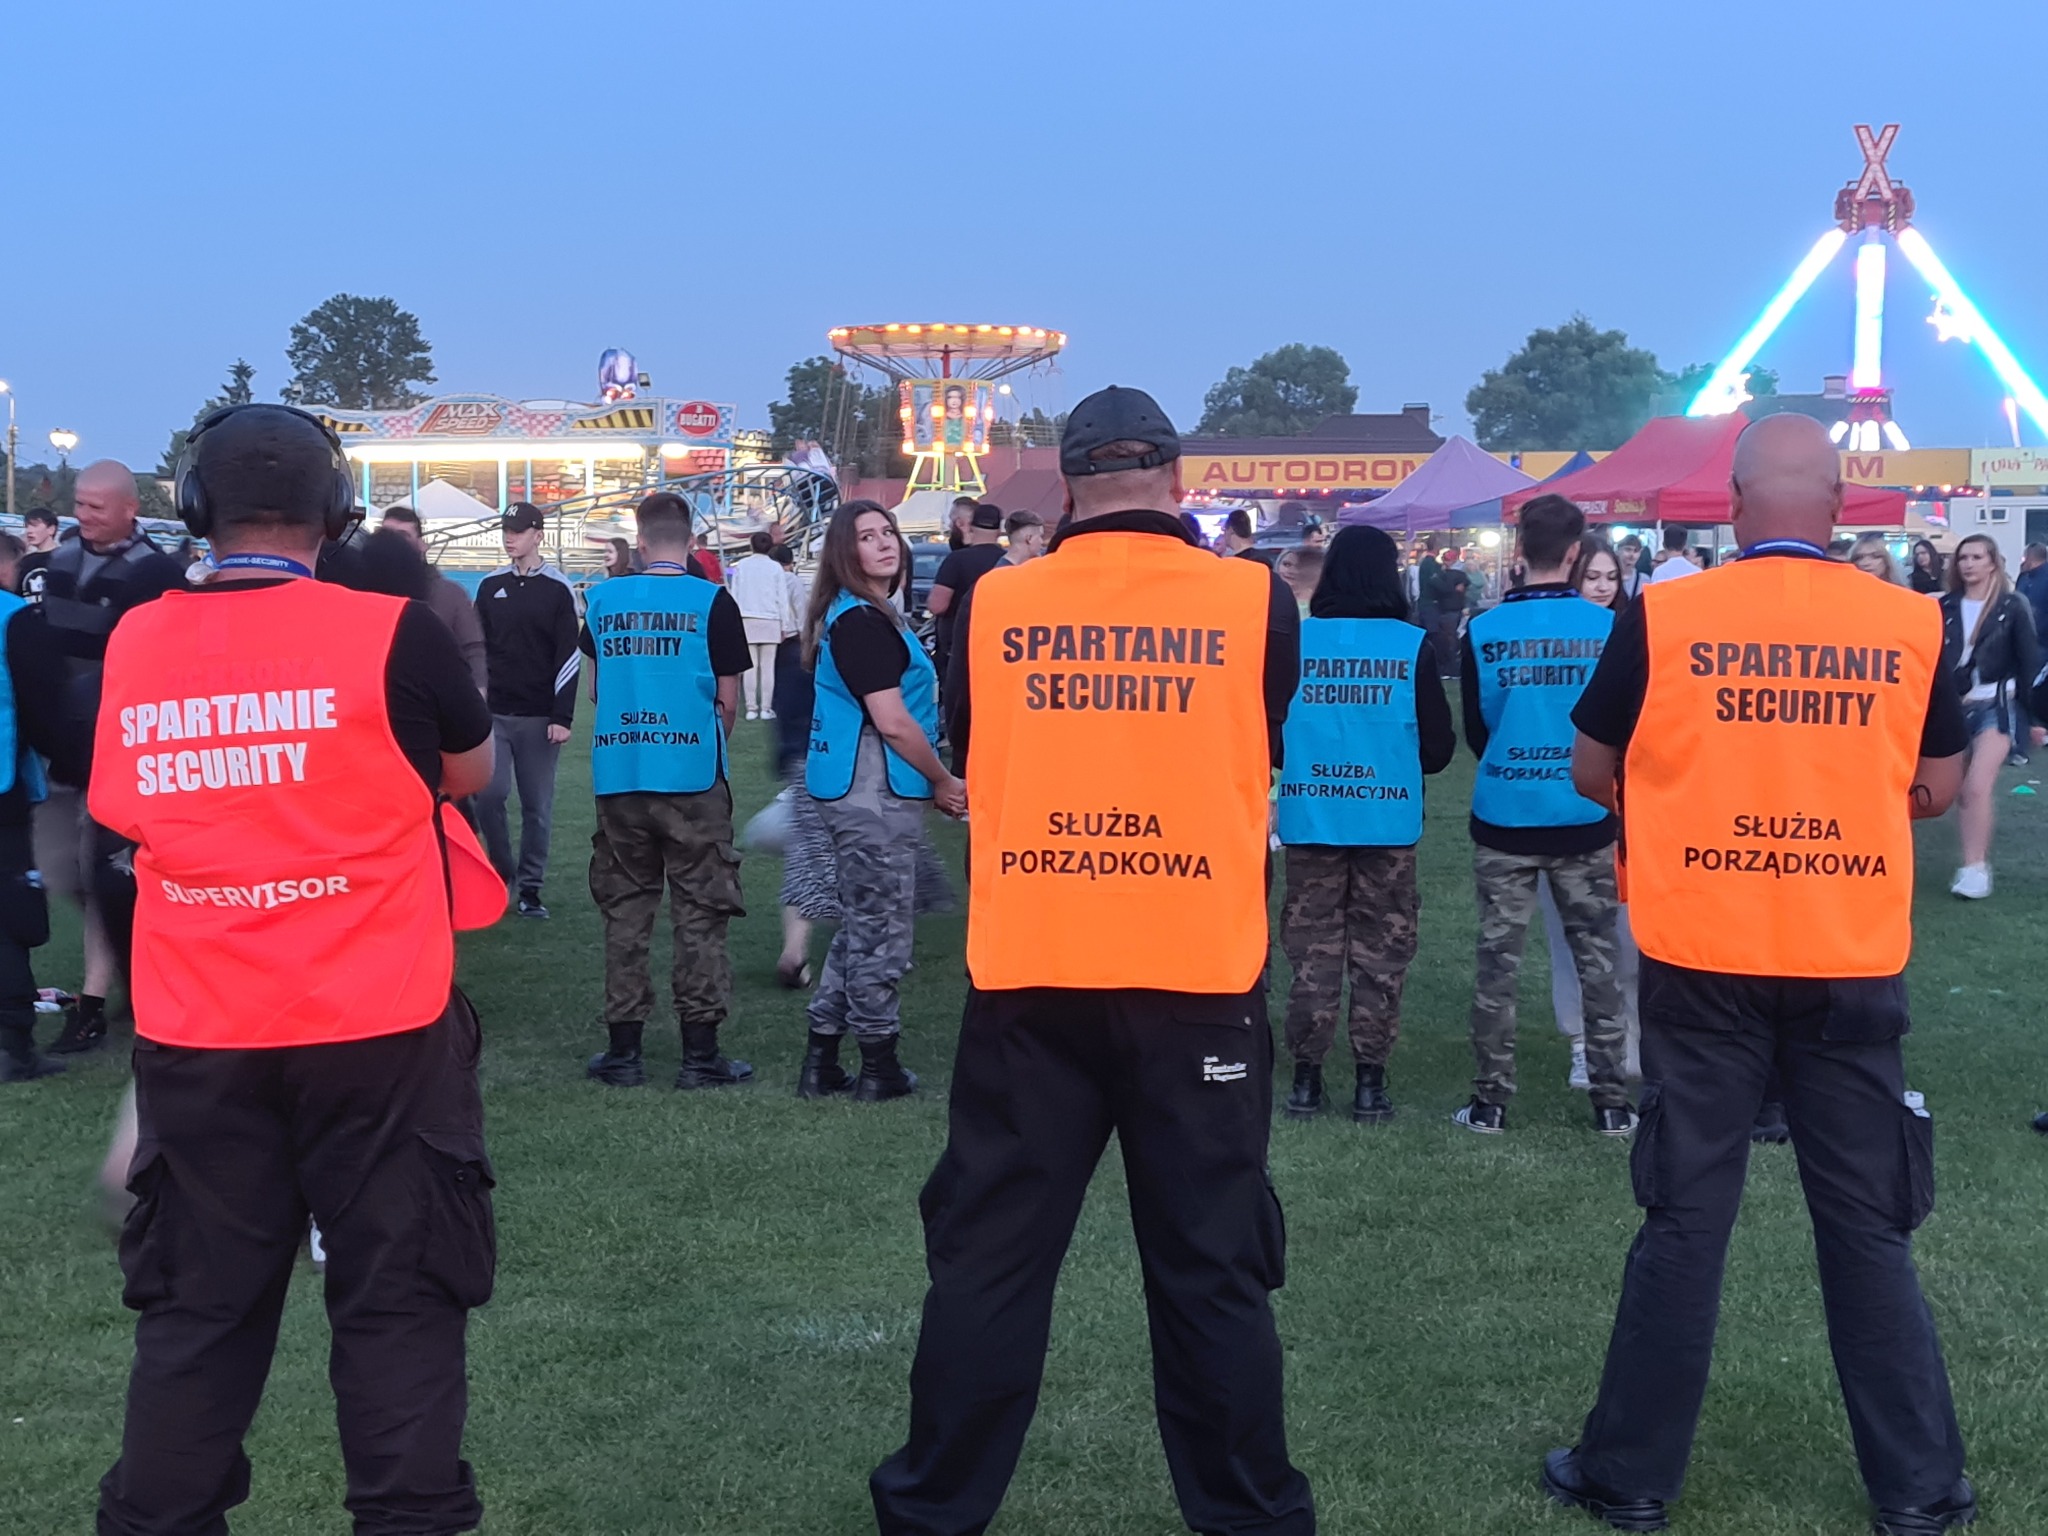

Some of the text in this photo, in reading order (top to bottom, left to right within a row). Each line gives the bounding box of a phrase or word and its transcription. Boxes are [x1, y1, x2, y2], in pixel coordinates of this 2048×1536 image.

[434, 418, 488, 430] SPEED
[441, 403, 497, 418] MAX
[1203, 459, 1427, 482] AUTODRO
[602, 635, 682, 657] SECURITY
[1002, 624, 1226, 667] SPARTANIE
[1303, 658, 1409, 681] PARTANIE
[1497, 664, 1589, 688] SECURITY
[1689, 641, 1902, 685] SPARTANIE
[1025, 672, 1197, 713] SECURITY
[1301, 683, 1393, 705] SECURITY
[1715, 686, 1877, 727] SECURITY
[119, 686, 338, 748] SPARTANIE
[136, 741, 308, 796] SECURITY
[1311, 761, 1376, 779] SŁUŻBA
[1280, 783, 1409, 800] INFORMACYJNA
[1048, 806, 1163, 839] SŁUŻBA
[1733, 811, 1842, 841] SŁUŻBA
[1001, 849, 1212, 881] PORZĄDKOWA
[1684, 846, 1887, 879] PORZĄDKOWA
[160, 875, 350, 910] SUPERVISOR
